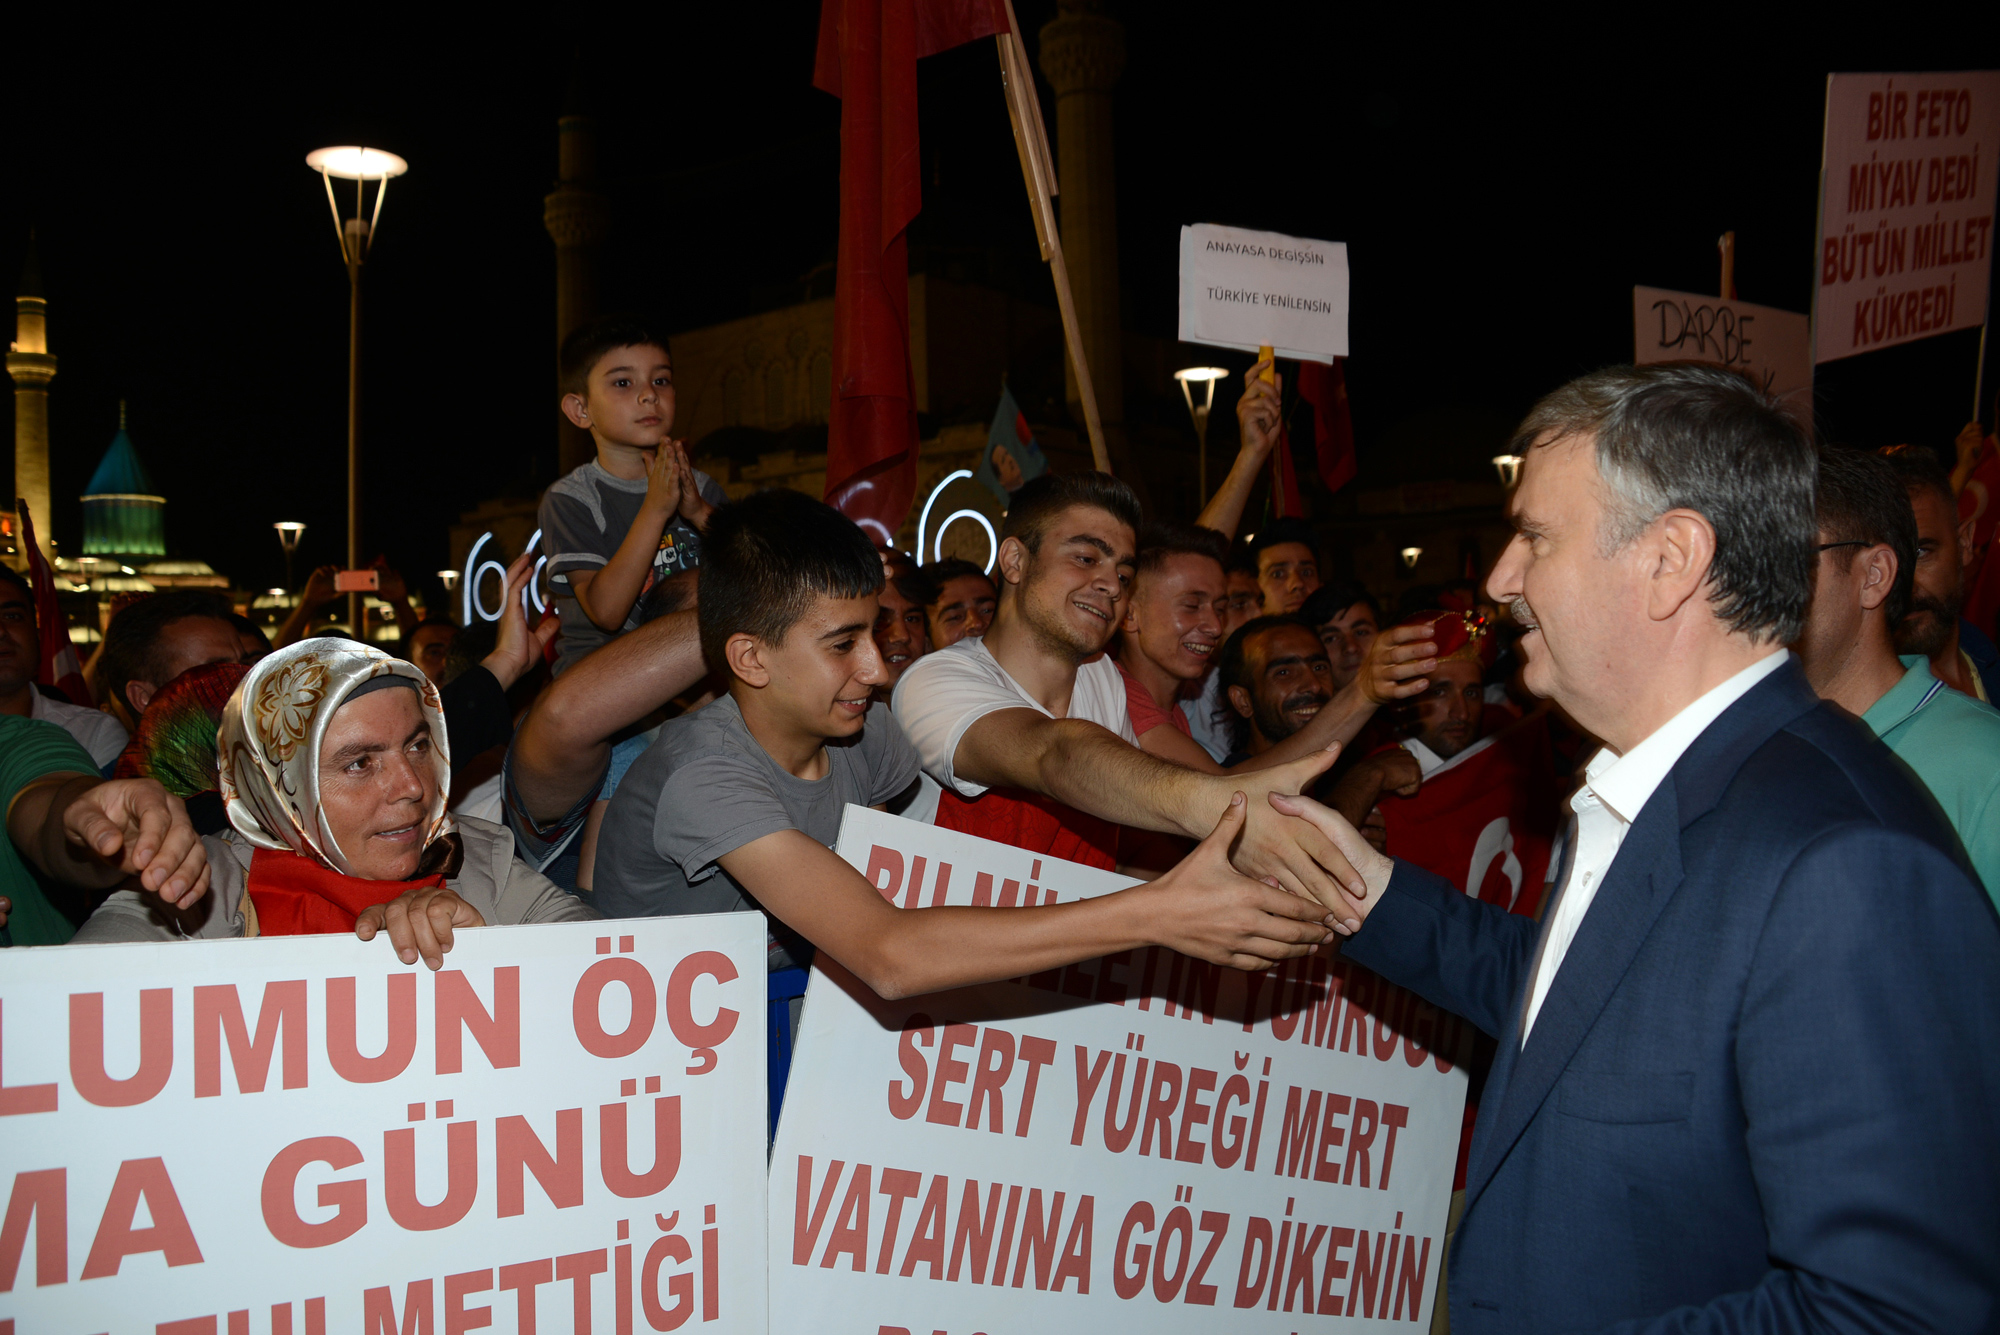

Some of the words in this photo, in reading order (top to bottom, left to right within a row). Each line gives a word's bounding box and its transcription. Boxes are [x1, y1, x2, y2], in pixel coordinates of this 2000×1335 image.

[1867, 78, 1908, 142] BİR
[1913, 88, 1972, 139] FETO
[1848, 150, 1923, 213] MİYAV
[1926, 143, 1979, 204] DEDİ
[1206, 240, 1266, 257] ANAYASA
[1822, 219, 1907, 286] BÜTÜN
[1911, 211, 1992, 271] MİLLET
[1207, 286, 1259, 304] TÜRKİYE
[1263, 293, 1331, 314] YENİLENSİN
[1653, 299, 1754, 364] DARBE
[1852, 271, 1956, 347] KÜKREDİ
[573, 935, 740, 1075] ÖÇ
[888, 1012, 1056, 1138] SERT
[1071, 1032, 1272, 1172] YÜREĞİ
[1275, 1086, 1409, 1191] MERT
[261, 1075, 682, 1249] GÜNÜ
[792, 1155, 1095, 1295] VATANINA
[1112, 1184, 1230, 1306] GÖZ
[1233, 1196, 1432, 1322] DİKENİN
